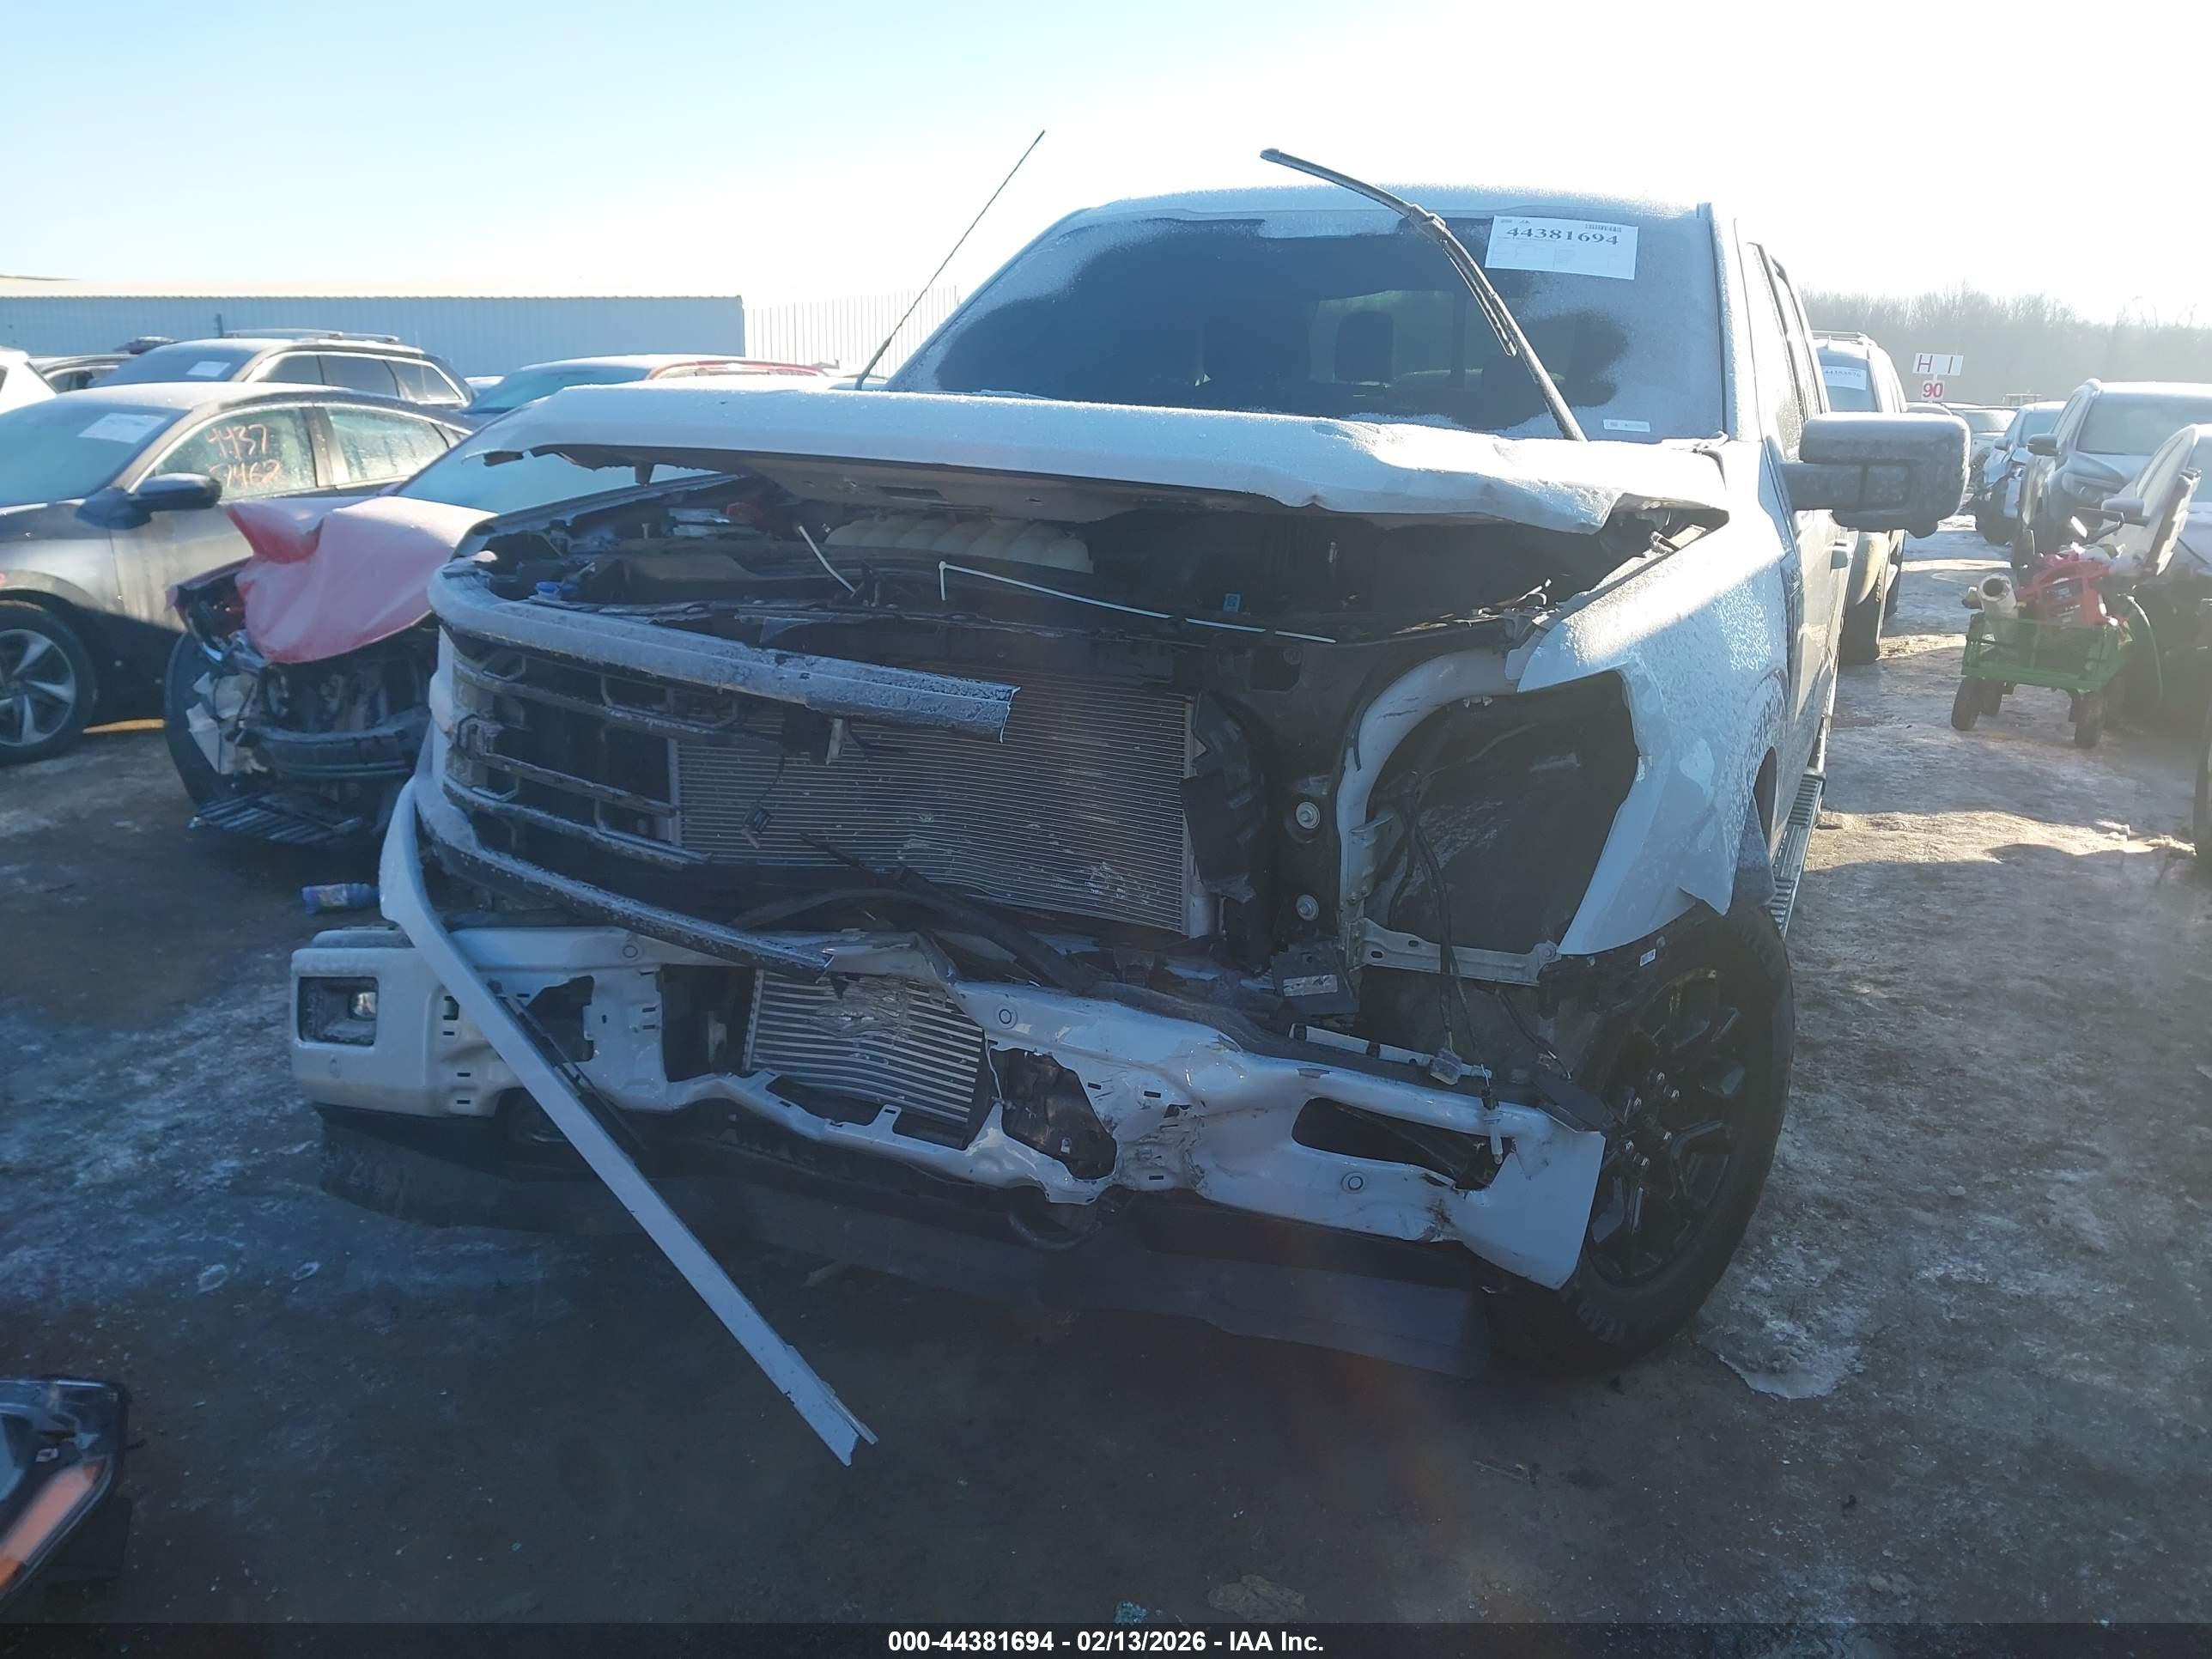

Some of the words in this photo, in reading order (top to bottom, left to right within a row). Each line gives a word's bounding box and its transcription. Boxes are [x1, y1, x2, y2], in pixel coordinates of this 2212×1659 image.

[1506, 227, 1617, 245] 44381694
[1917, 354, 1933, 373] H
[1923, 382, 1943, 398] 90
[205, 424, 267, 461] 4437
